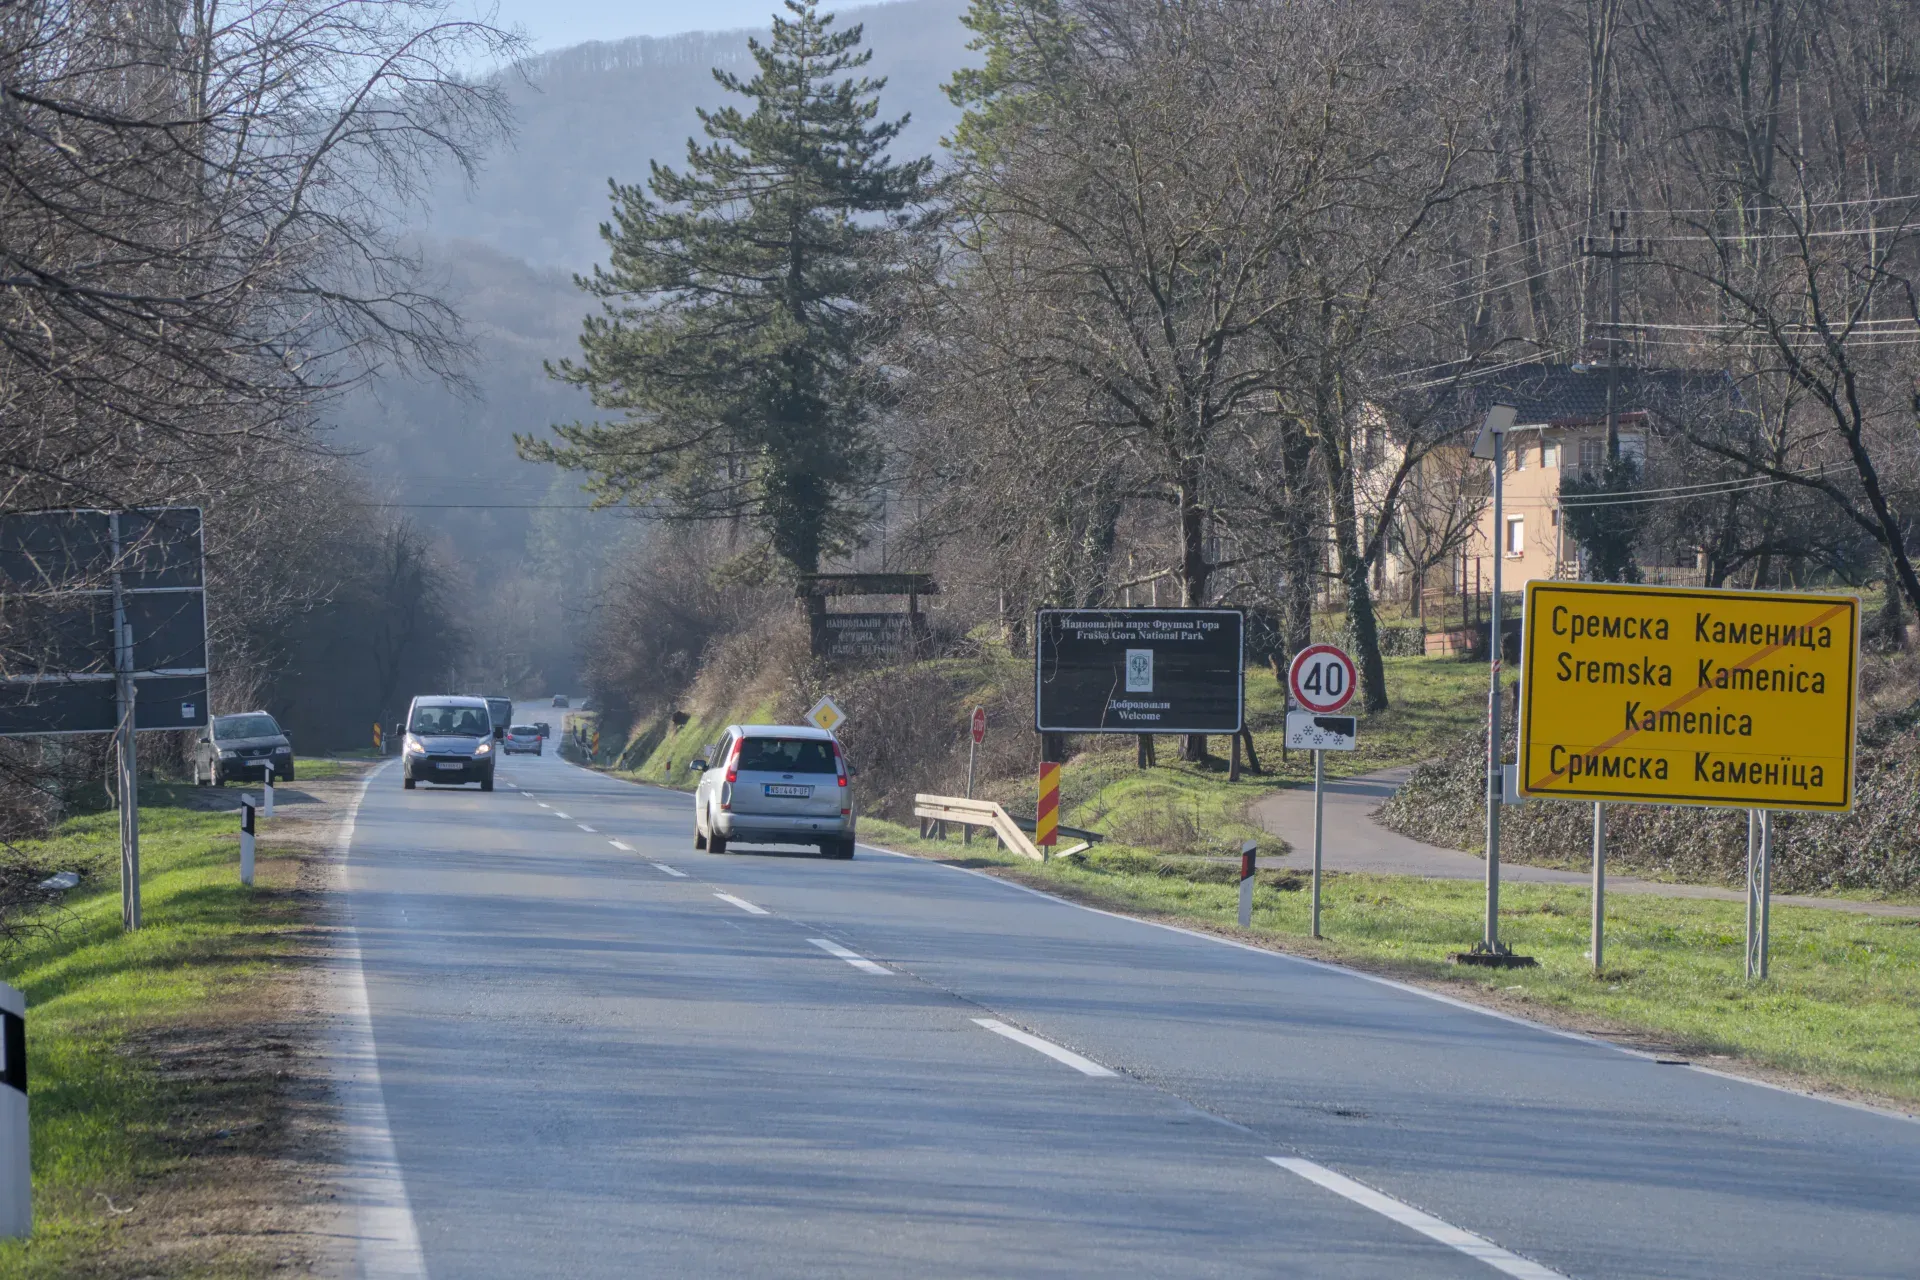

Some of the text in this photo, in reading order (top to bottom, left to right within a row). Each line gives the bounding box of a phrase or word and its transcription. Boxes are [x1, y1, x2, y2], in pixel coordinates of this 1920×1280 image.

[1077, 630, 1204, 640] Fruška Gora National Park
[1125, 621, 1150, 630] парк
[1152, 619, 1194, 631] Фрушка
[1196, 620, 1220, 631] Гора
[1552, 605, 1832, 651] Сремска Каменица
[1303, 662, 1343, 696] 40
[1556, 652, 1826, 694] Sremska Kamenica
[1108, 699, 1171, 710] Добродошли
[1118, 710, 1161, 720] Welcome
[973, 718, 985, 732] STOP
[1624, 701, 1753, 736] Kamenica
[1550, 744, 1669, 784] Сримска
